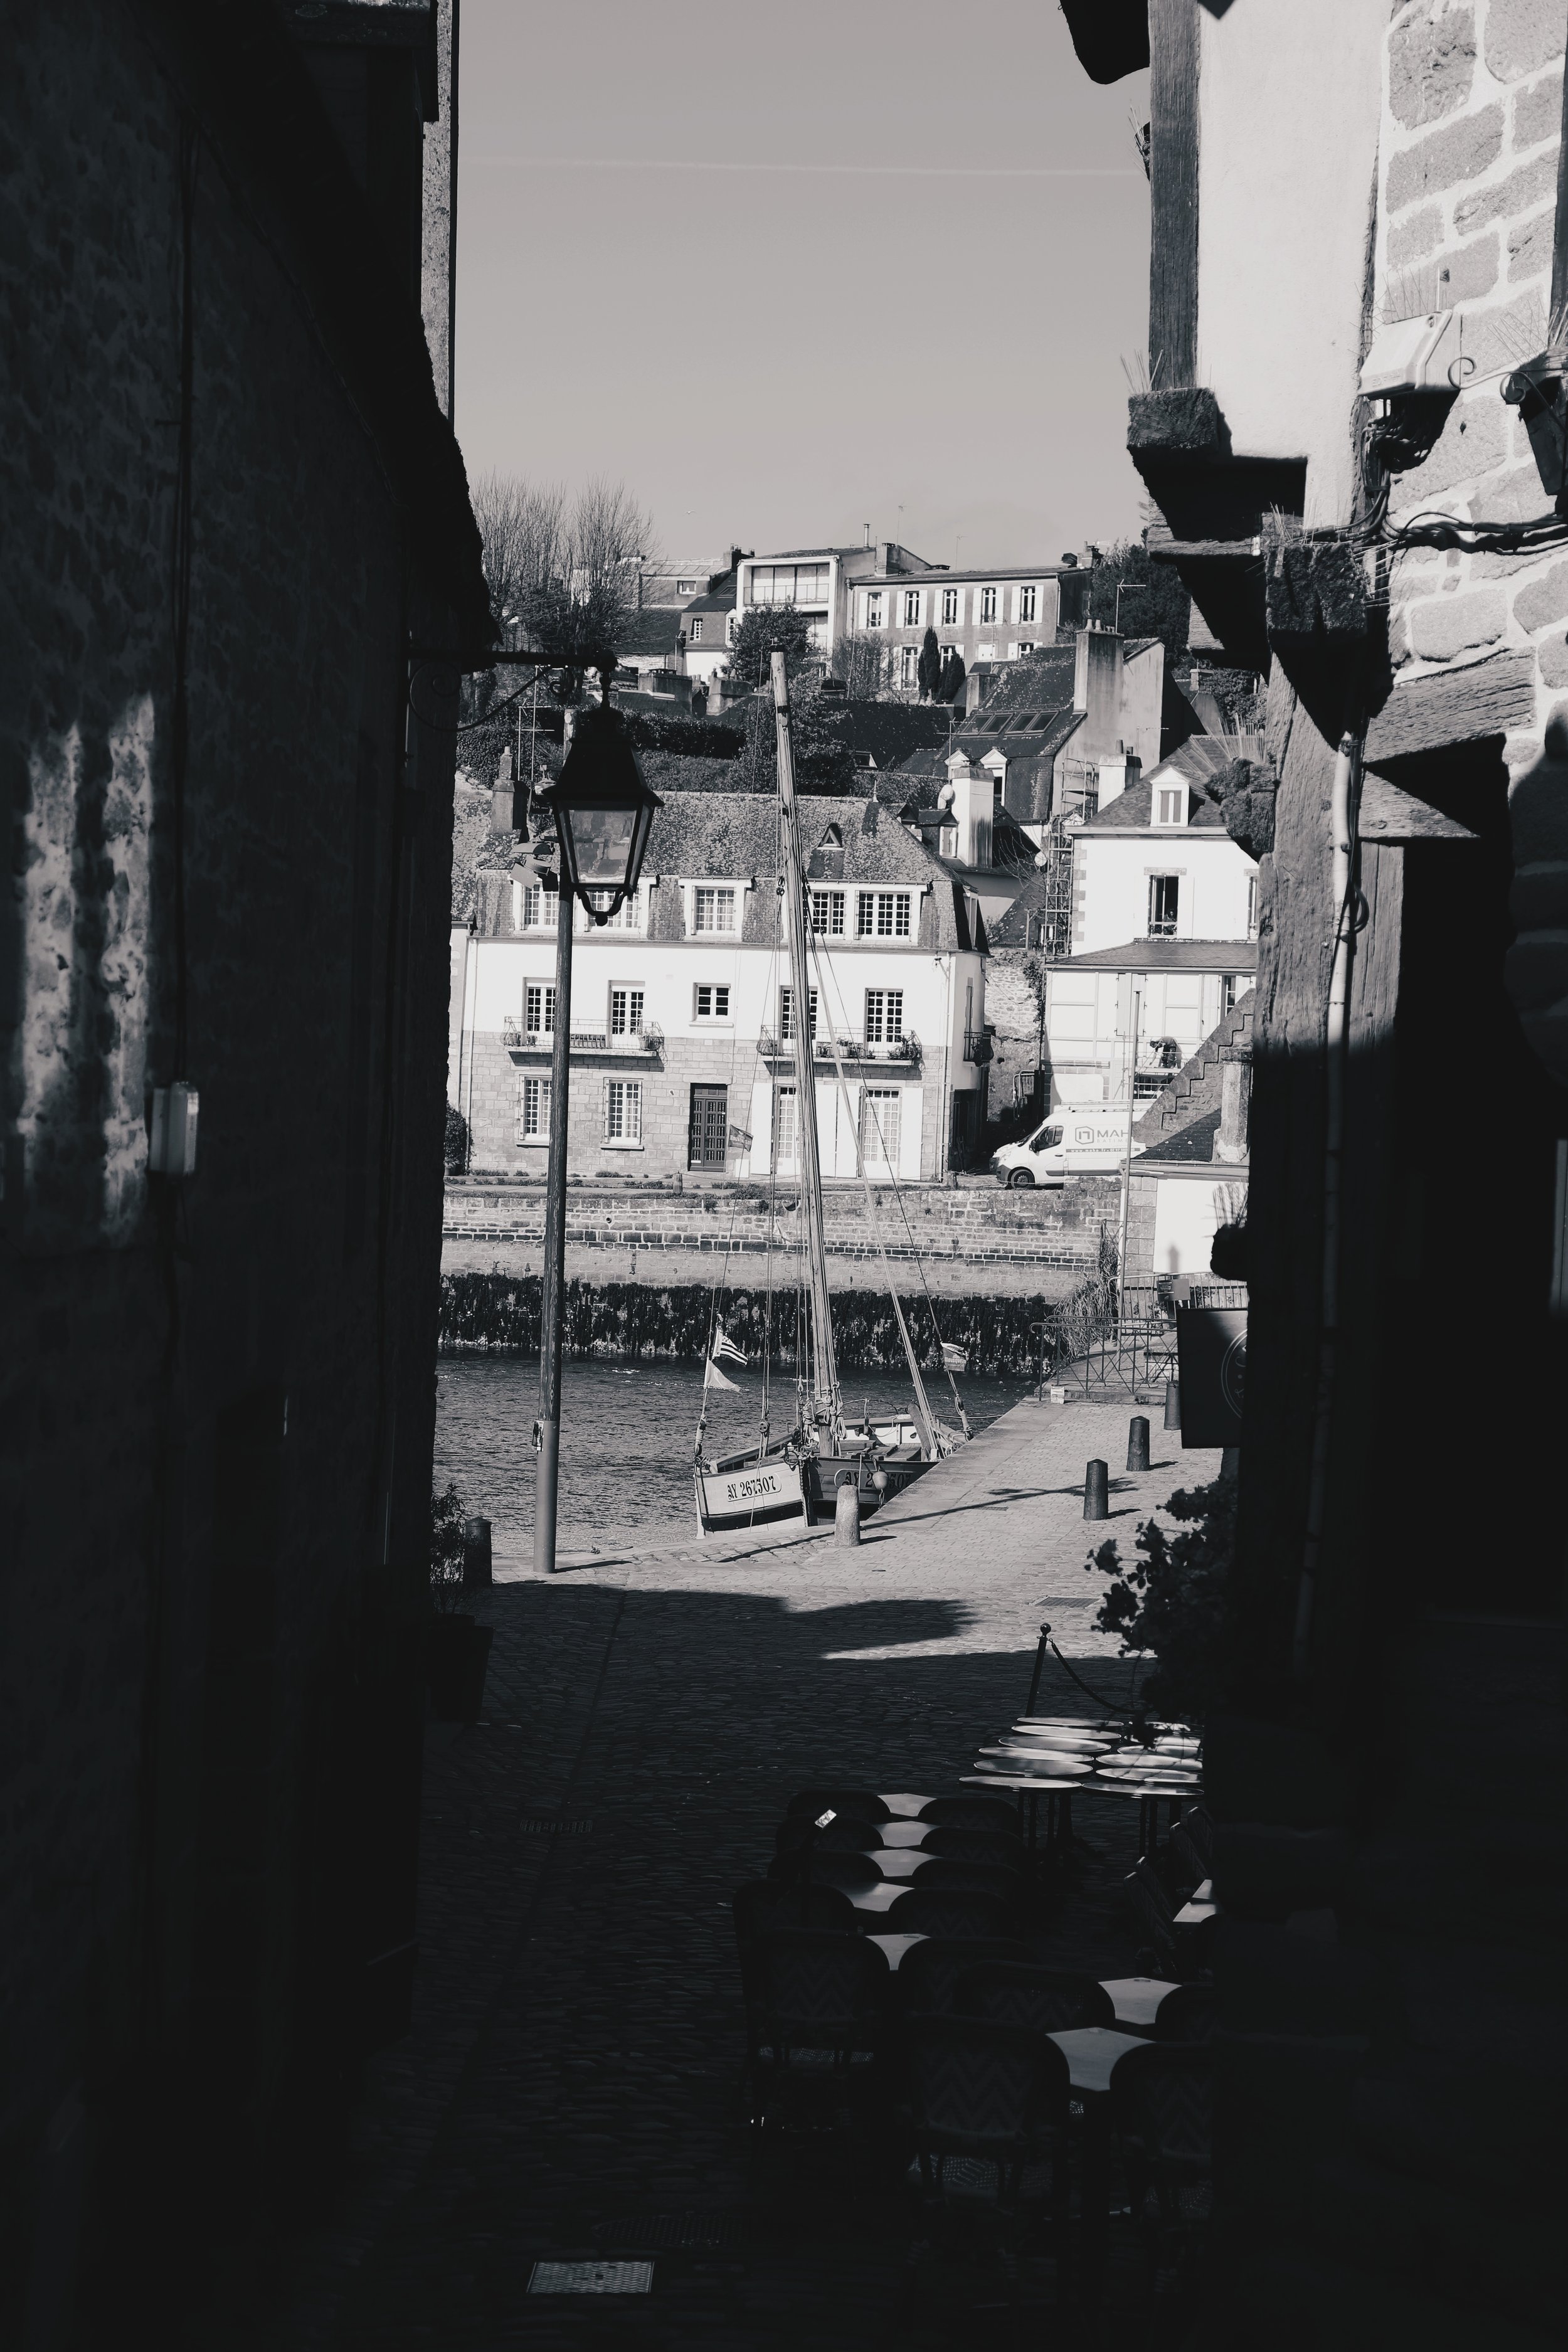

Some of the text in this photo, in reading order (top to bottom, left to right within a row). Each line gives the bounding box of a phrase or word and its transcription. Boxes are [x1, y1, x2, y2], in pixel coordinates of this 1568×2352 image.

[728, 1476, 776, 1500] AY 267507
[866, 1472, 911, 1490] 2507
